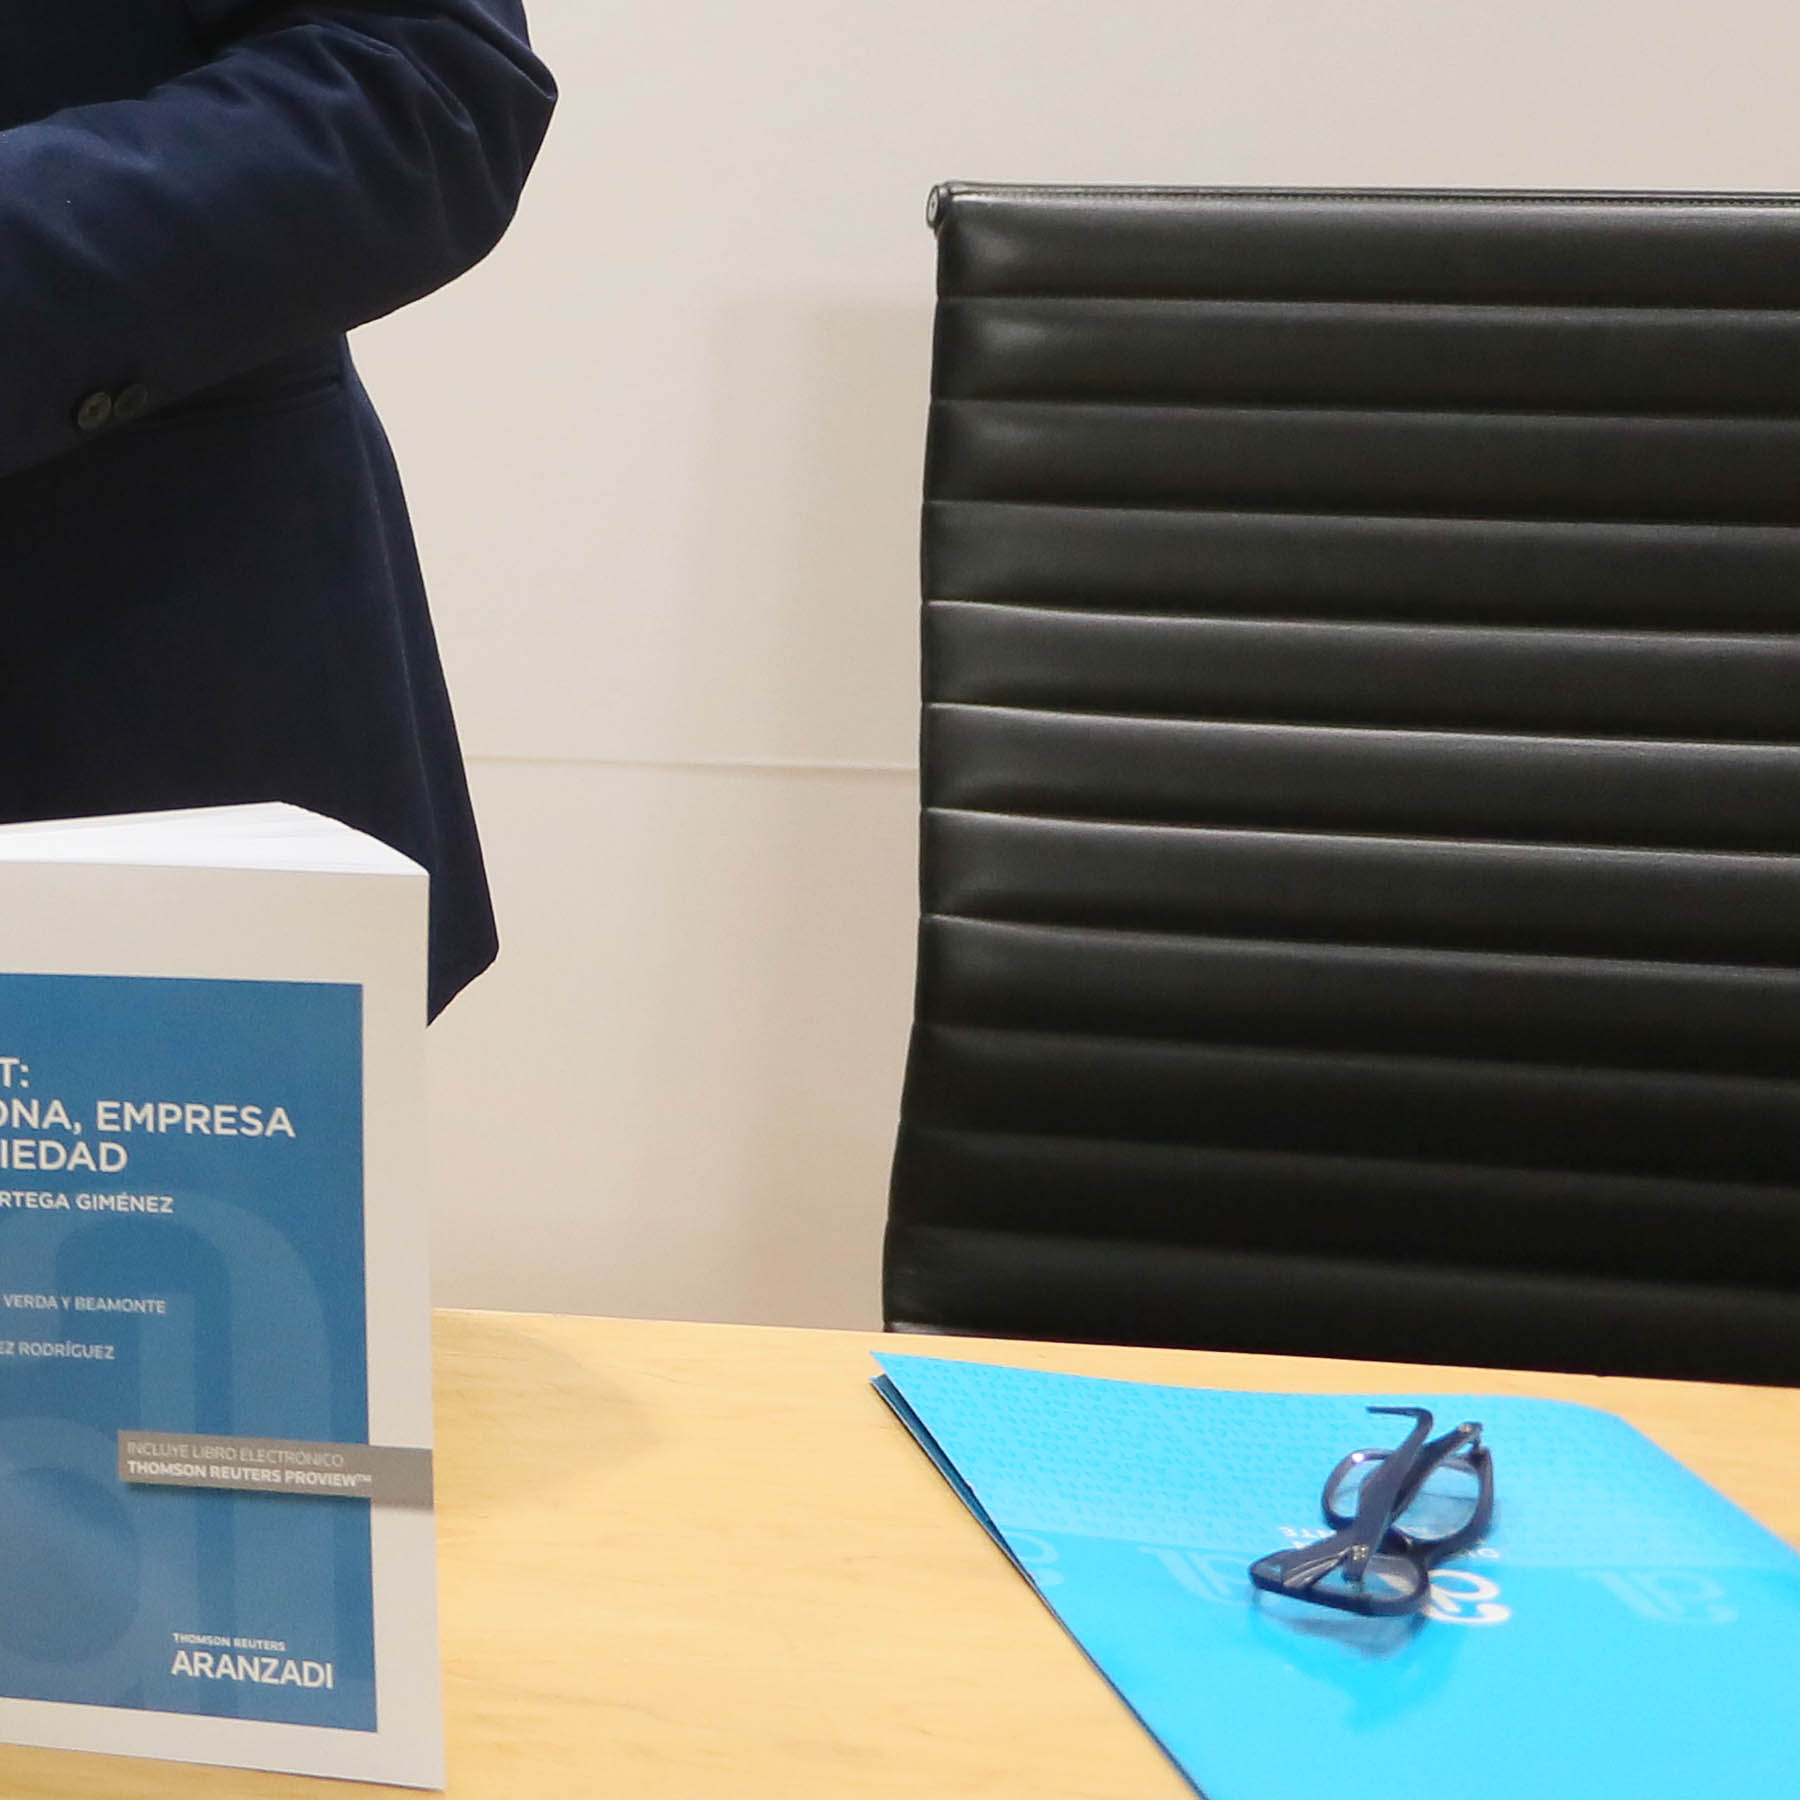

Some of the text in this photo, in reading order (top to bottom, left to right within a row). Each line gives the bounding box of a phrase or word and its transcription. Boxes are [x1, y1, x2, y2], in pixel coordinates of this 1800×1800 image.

[96, 1100, 297, 1139] EMPRESA
[75, 1191, 175, 1214] GIMÉNEZ
[3, 1293, 59, 1311] VERDA
[61, 1296, 73, 1311] Y
[74, 1296, 167, 1315] BEAMONTE
[17, 1339, 116, 1360] RODRÍGUEZ
[127, 1441, 345, 1468] INCLUYE LIBRO ELECTRÓNICO
[127, 1459, 208, 1480] THOMSON
[209, 1464, 283, 1483] REUTERS
[172, 1632, 286, 1652] THOMSON REUTERS
[170, 1650, 335, 1690] ARANZADI
